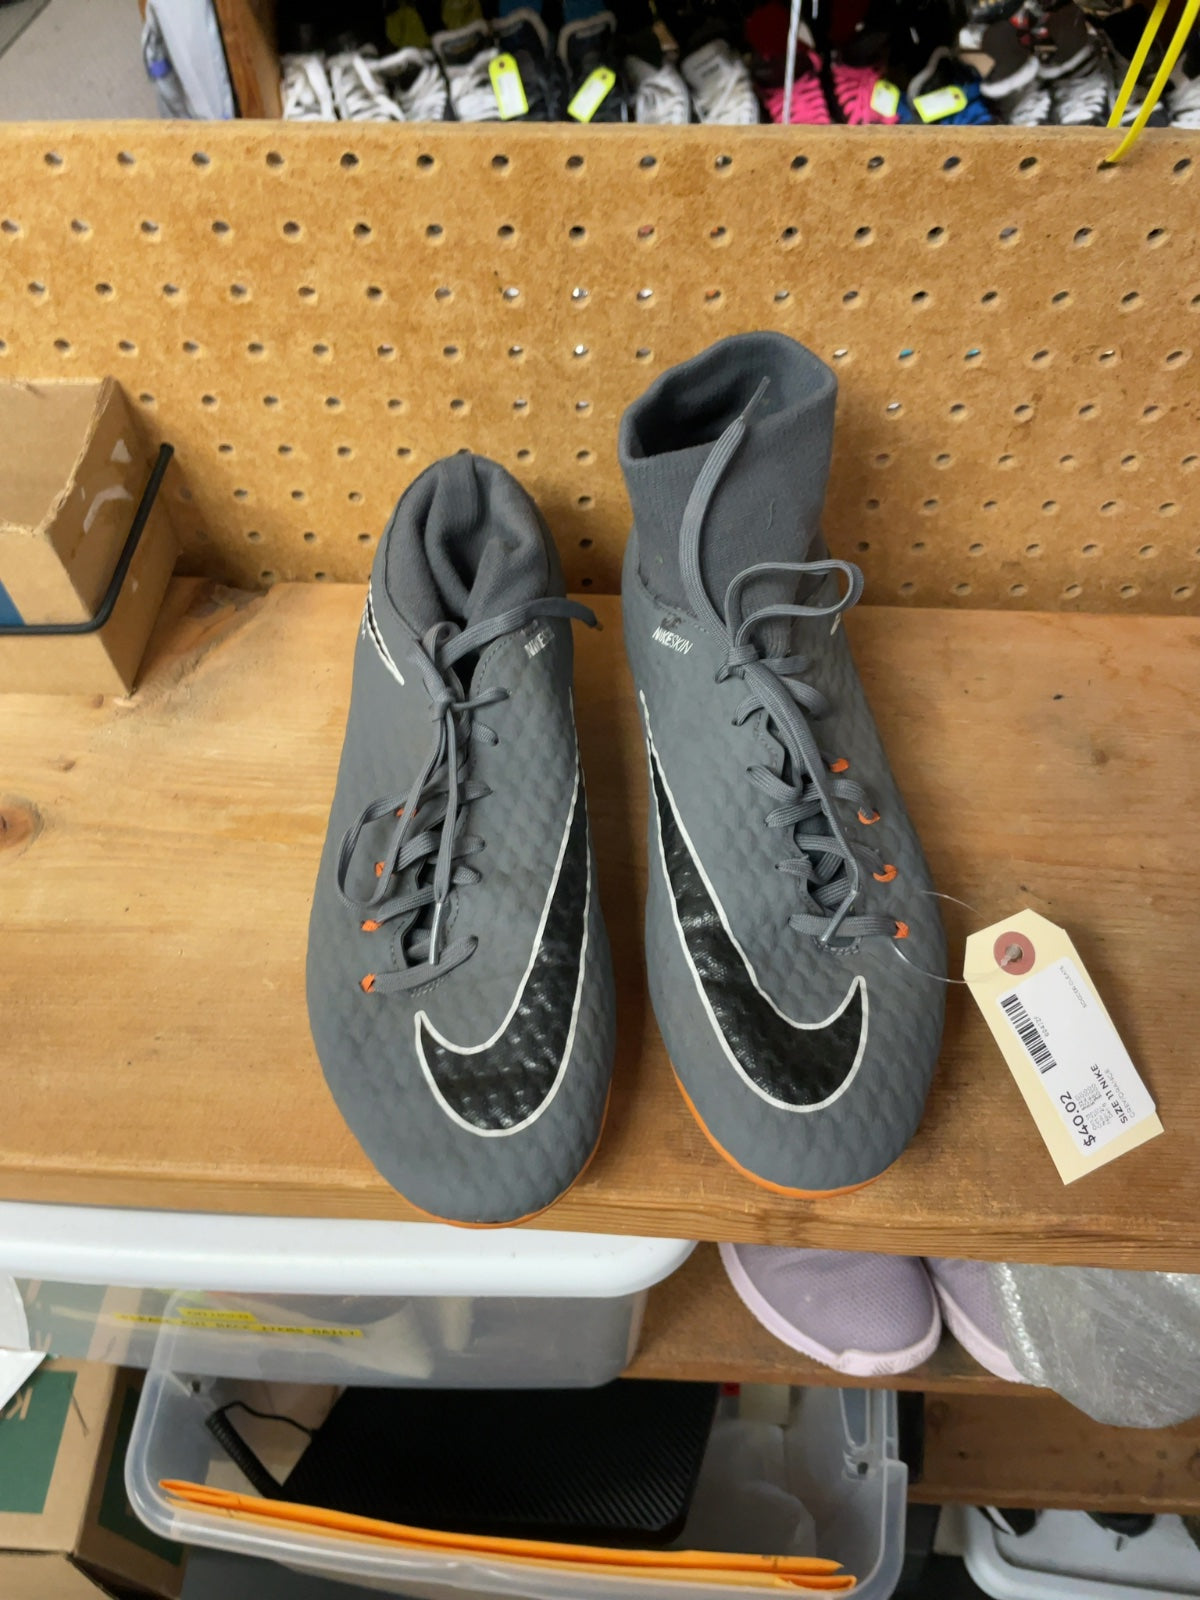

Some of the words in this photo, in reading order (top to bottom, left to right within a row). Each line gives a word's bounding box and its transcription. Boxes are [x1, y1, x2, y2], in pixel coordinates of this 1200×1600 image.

[652, 626, 693, 654] NIKESKIN
[1090, 1063, 1110, 1090] NIKE
[1105, 1090, 1114, 1100] 11
[1059, 1090, 1098, 1148] $40.02
[1110, 1100, 1128, 1124] SIZE
